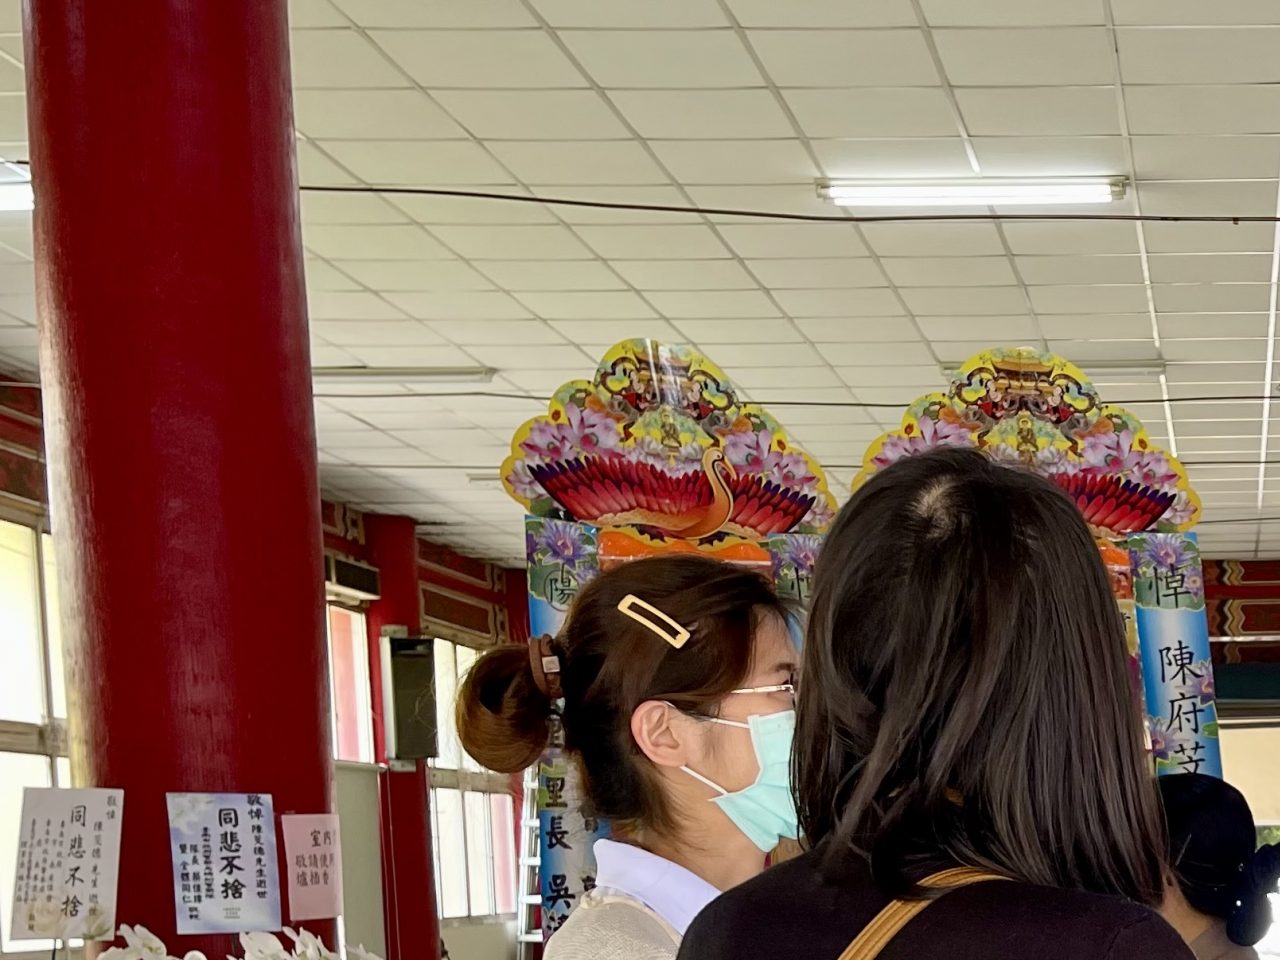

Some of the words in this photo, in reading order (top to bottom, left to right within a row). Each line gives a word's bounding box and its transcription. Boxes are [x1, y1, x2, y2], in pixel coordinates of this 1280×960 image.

[1148, 564, 1192, 609] 悼
[60, 804, 87, 917] 同悲不捨
[218, 808, 247, 899] 同悲不捨
